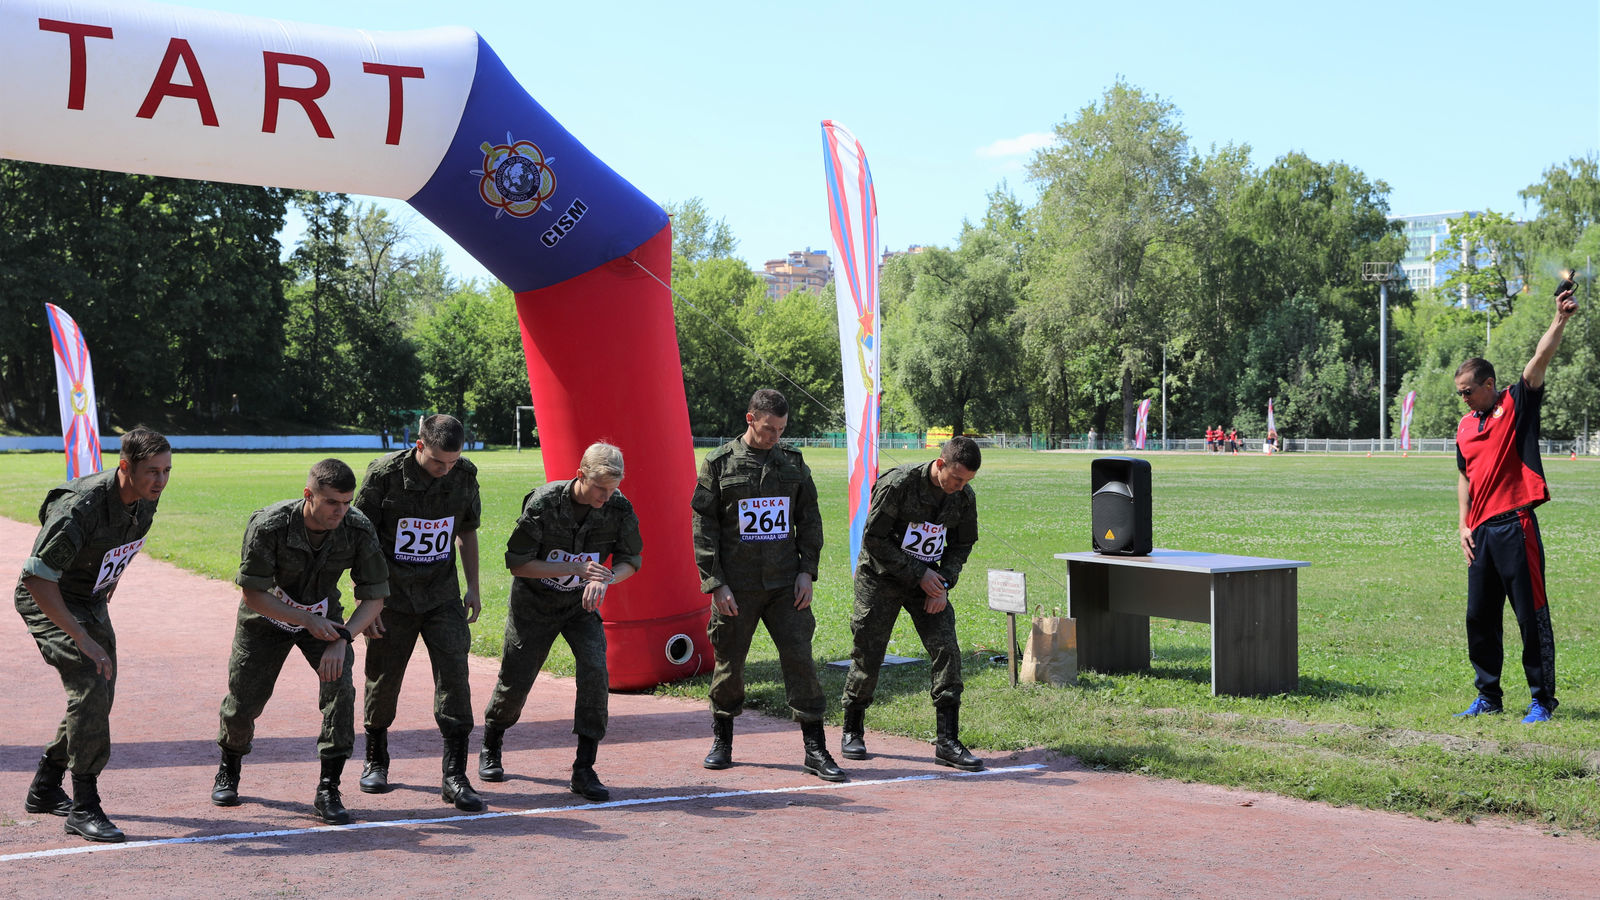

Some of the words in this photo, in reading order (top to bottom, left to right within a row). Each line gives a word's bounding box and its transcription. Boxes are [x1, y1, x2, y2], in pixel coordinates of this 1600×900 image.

[540, 198, 589, 248] CISM
[752, 499, 785, 509] ЦСКА
[413, 519, 449, 530] ЦСКА
[743, 510, 787, 533] 264
[398, 530, 449, 555] 250
[905, 530, 944, 556] 262
